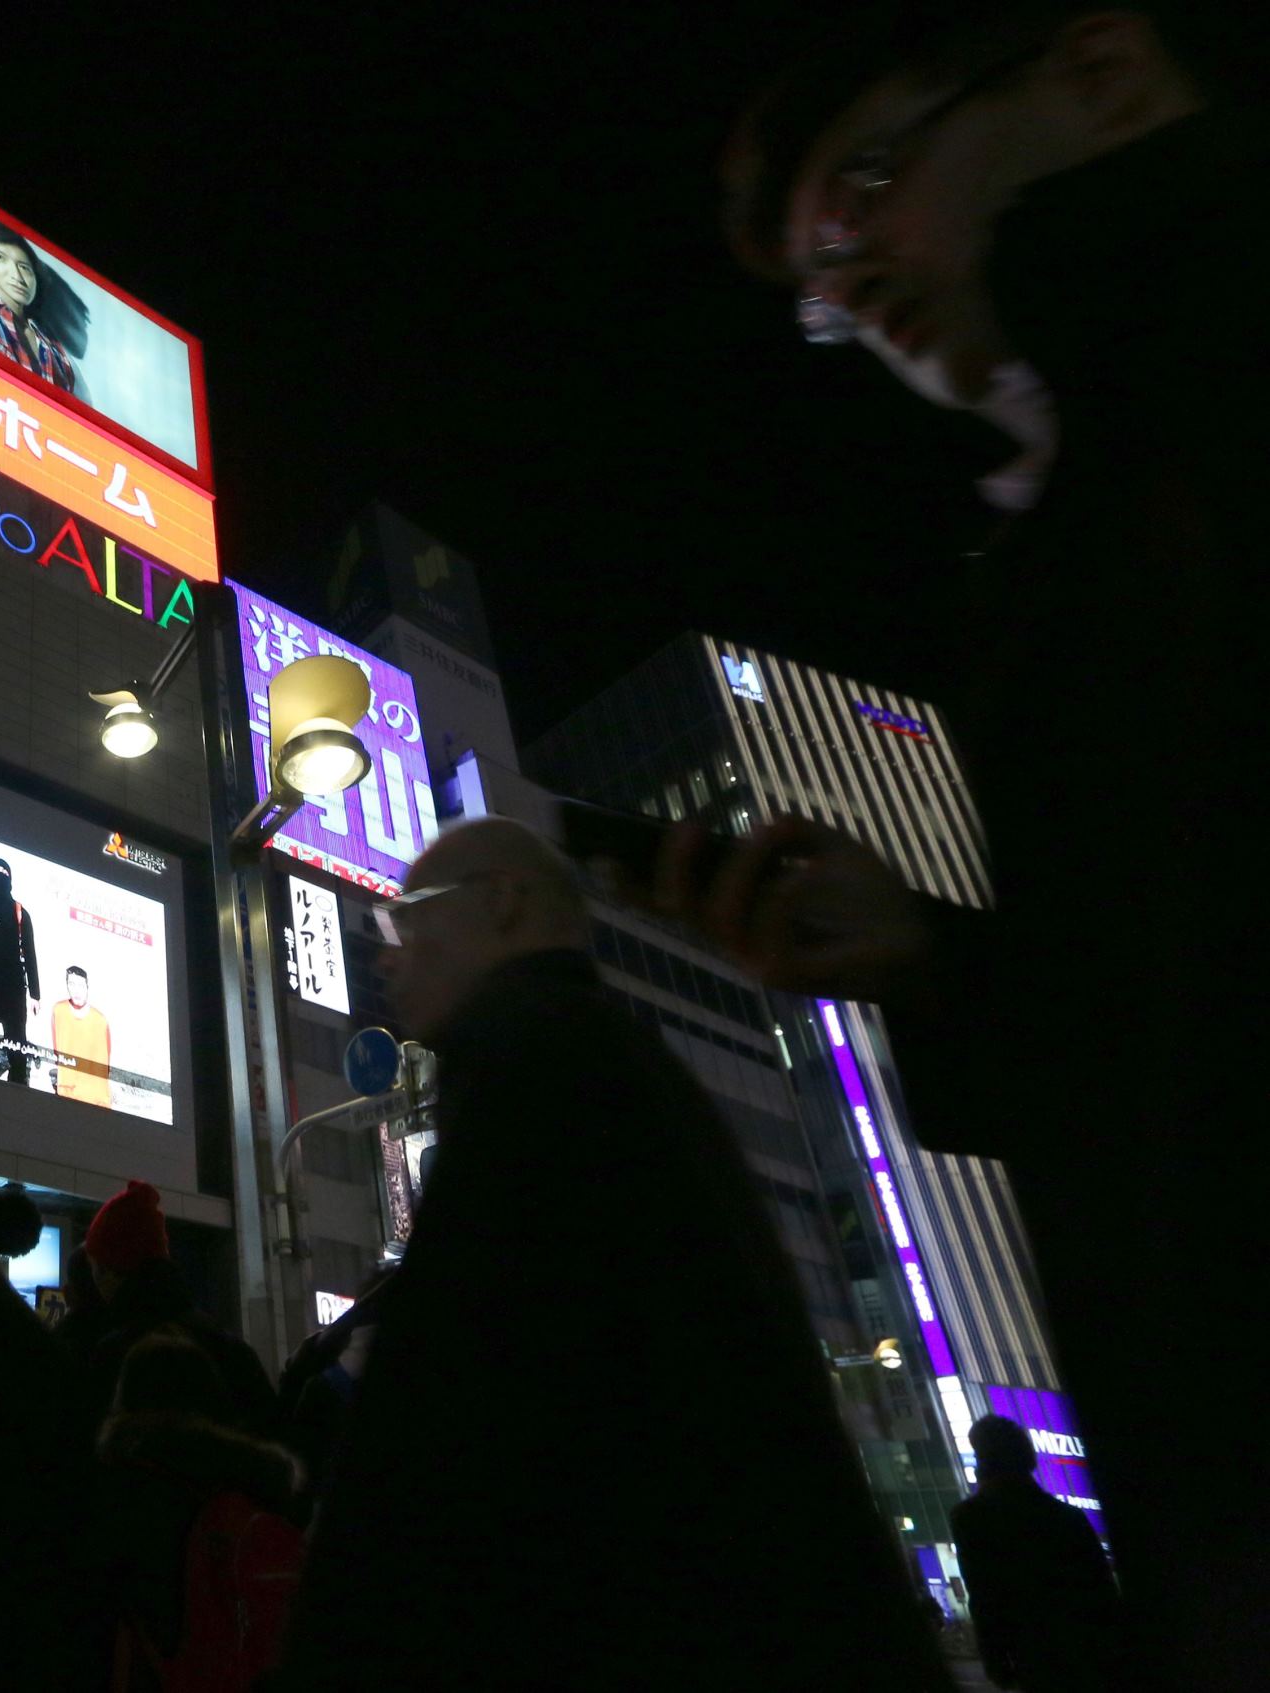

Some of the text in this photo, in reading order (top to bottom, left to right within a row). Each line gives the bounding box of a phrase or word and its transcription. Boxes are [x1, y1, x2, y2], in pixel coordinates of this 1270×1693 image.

[36, 517, 194, 630] ALTA
[246, 603, 421, 742] 洋の
[296, 889, 322, 995] ルノアール
